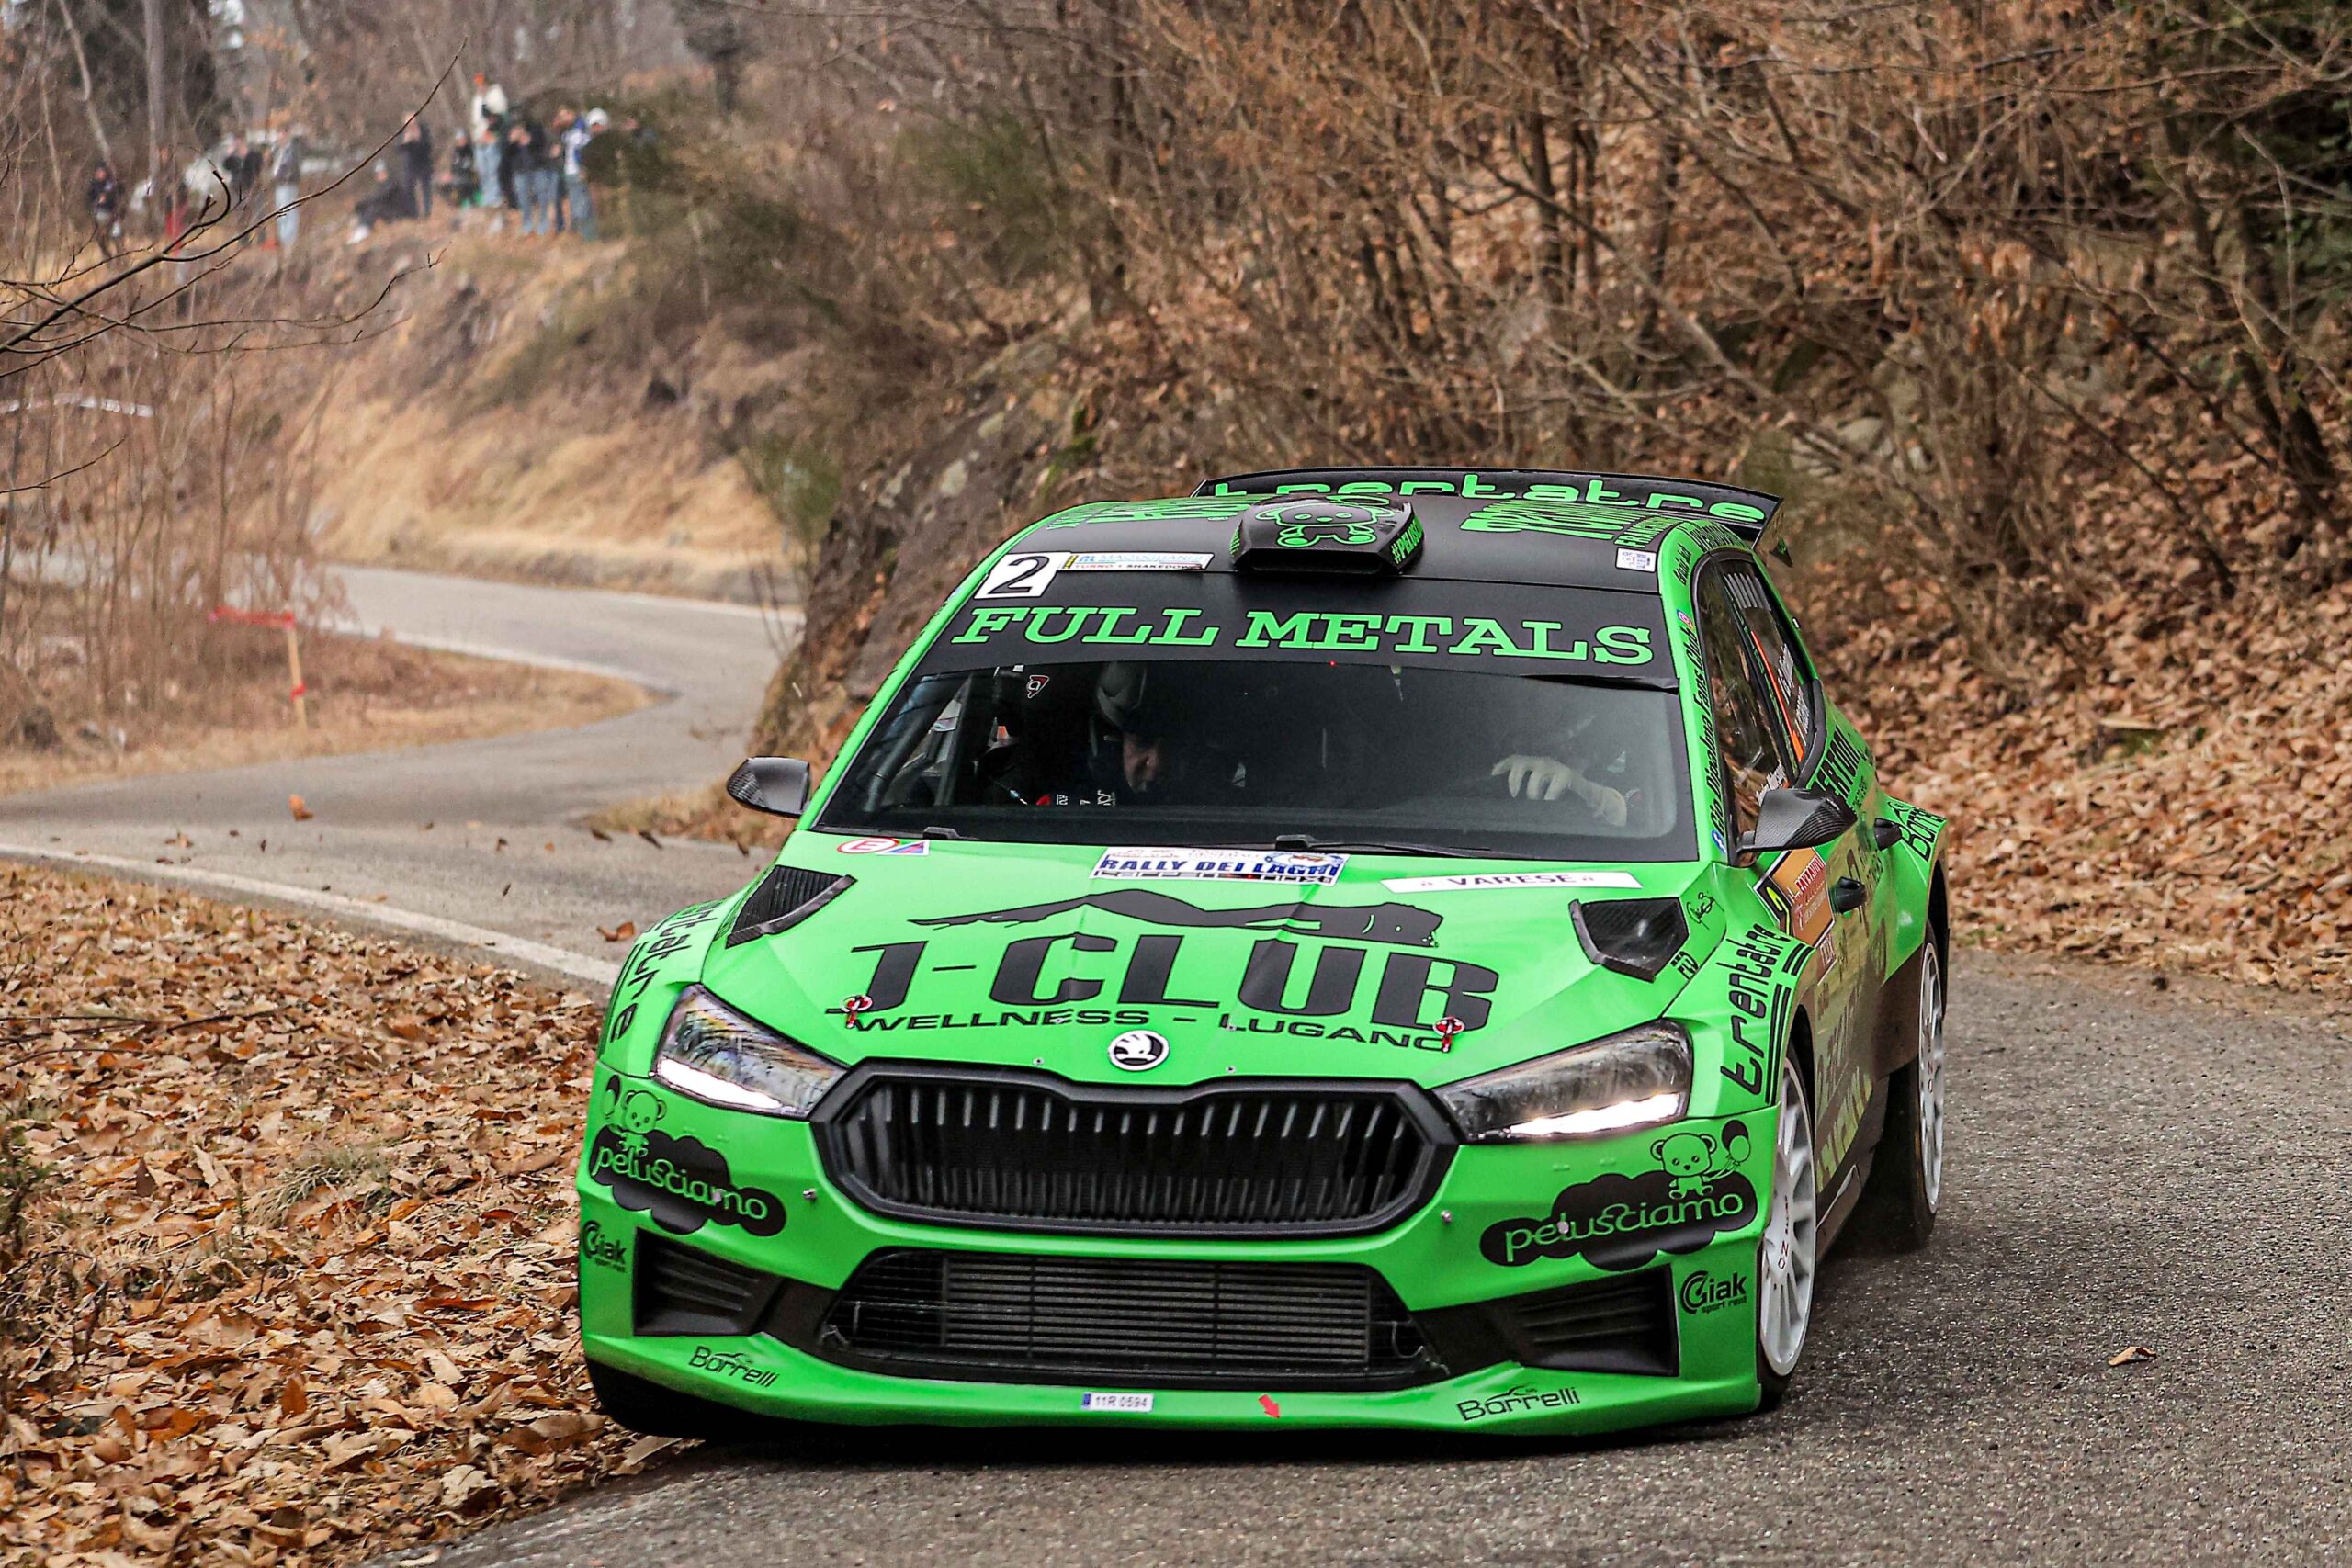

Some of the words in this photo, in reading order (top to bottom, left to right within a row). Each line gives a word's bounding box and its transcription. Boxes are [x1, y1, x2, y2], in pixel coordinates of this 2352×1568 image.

[987, 556, 1050, 595] 2
[950, 606, 1220, 646] FULL
[1235, 610, 1654, 666] METALS
[1679, 626, 1703, 671] Club
[1693, 669, 1712, 717] Fans
[1100, 859, 1187, 871] RALLY
[1194, 861, 1247, 872] DEI
[1253, 863, 1343, 876] LAGHI
[1449, 874, 1577, 885] VARESE
[854, 1009, 1150, 1032] WELLNESS
[1218, 1013, 1452, 1053] LUGANO
[592, 1146, 768, 1220] pelusciamo
[1505, 1193, 1744, 1262] pelusciamo
